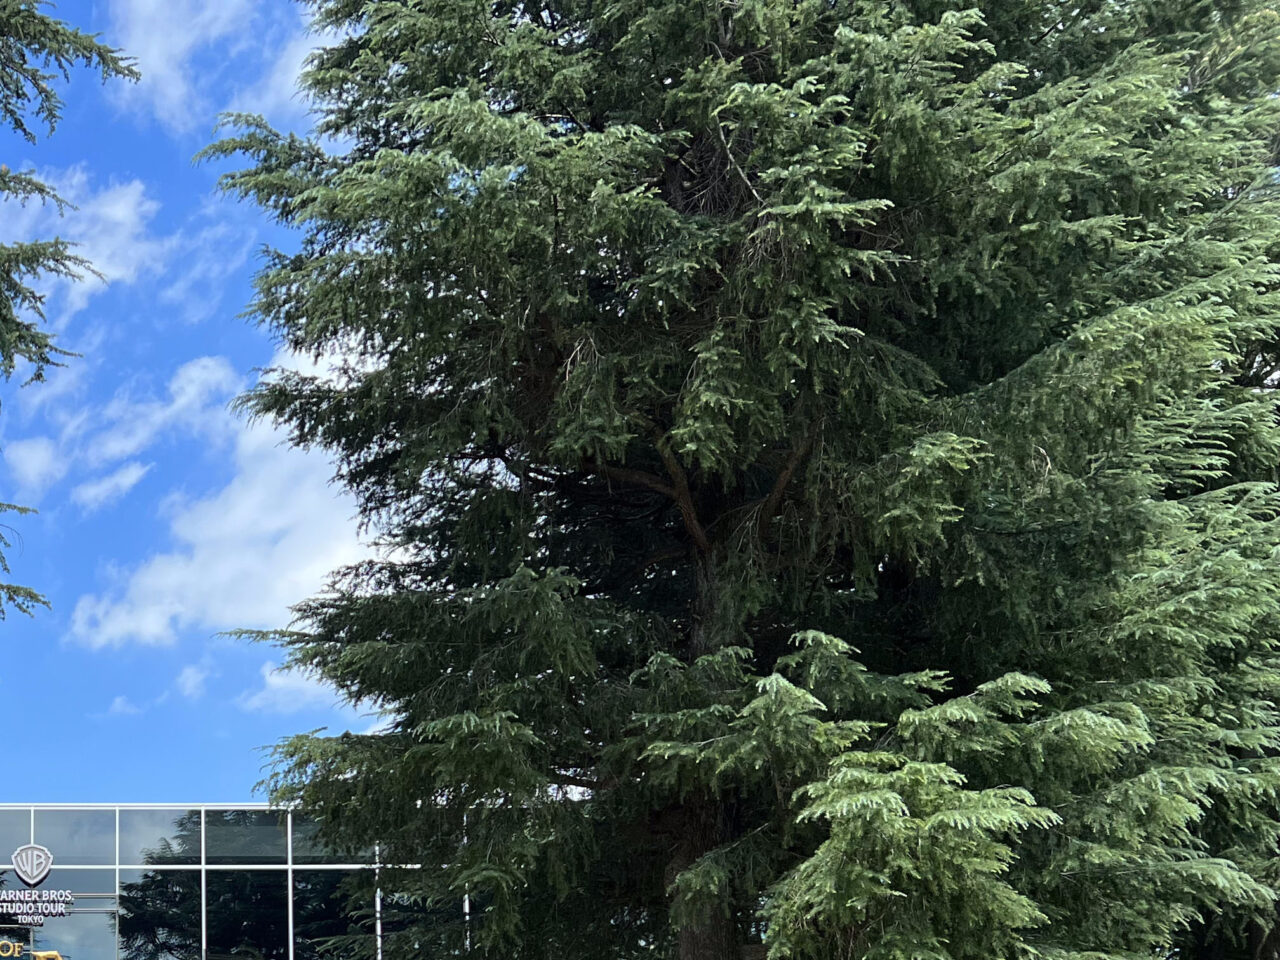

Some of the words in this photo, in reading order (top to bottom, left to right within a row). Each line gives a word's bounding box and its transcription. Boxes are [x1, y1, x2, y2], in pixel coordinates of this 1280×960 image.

[17, 850, 46, 879] WB
[42, 889, 75, 901] BROS.
[37, 902, 66, 914] TOUR
[17, 915, 44, 924] TOKYO
